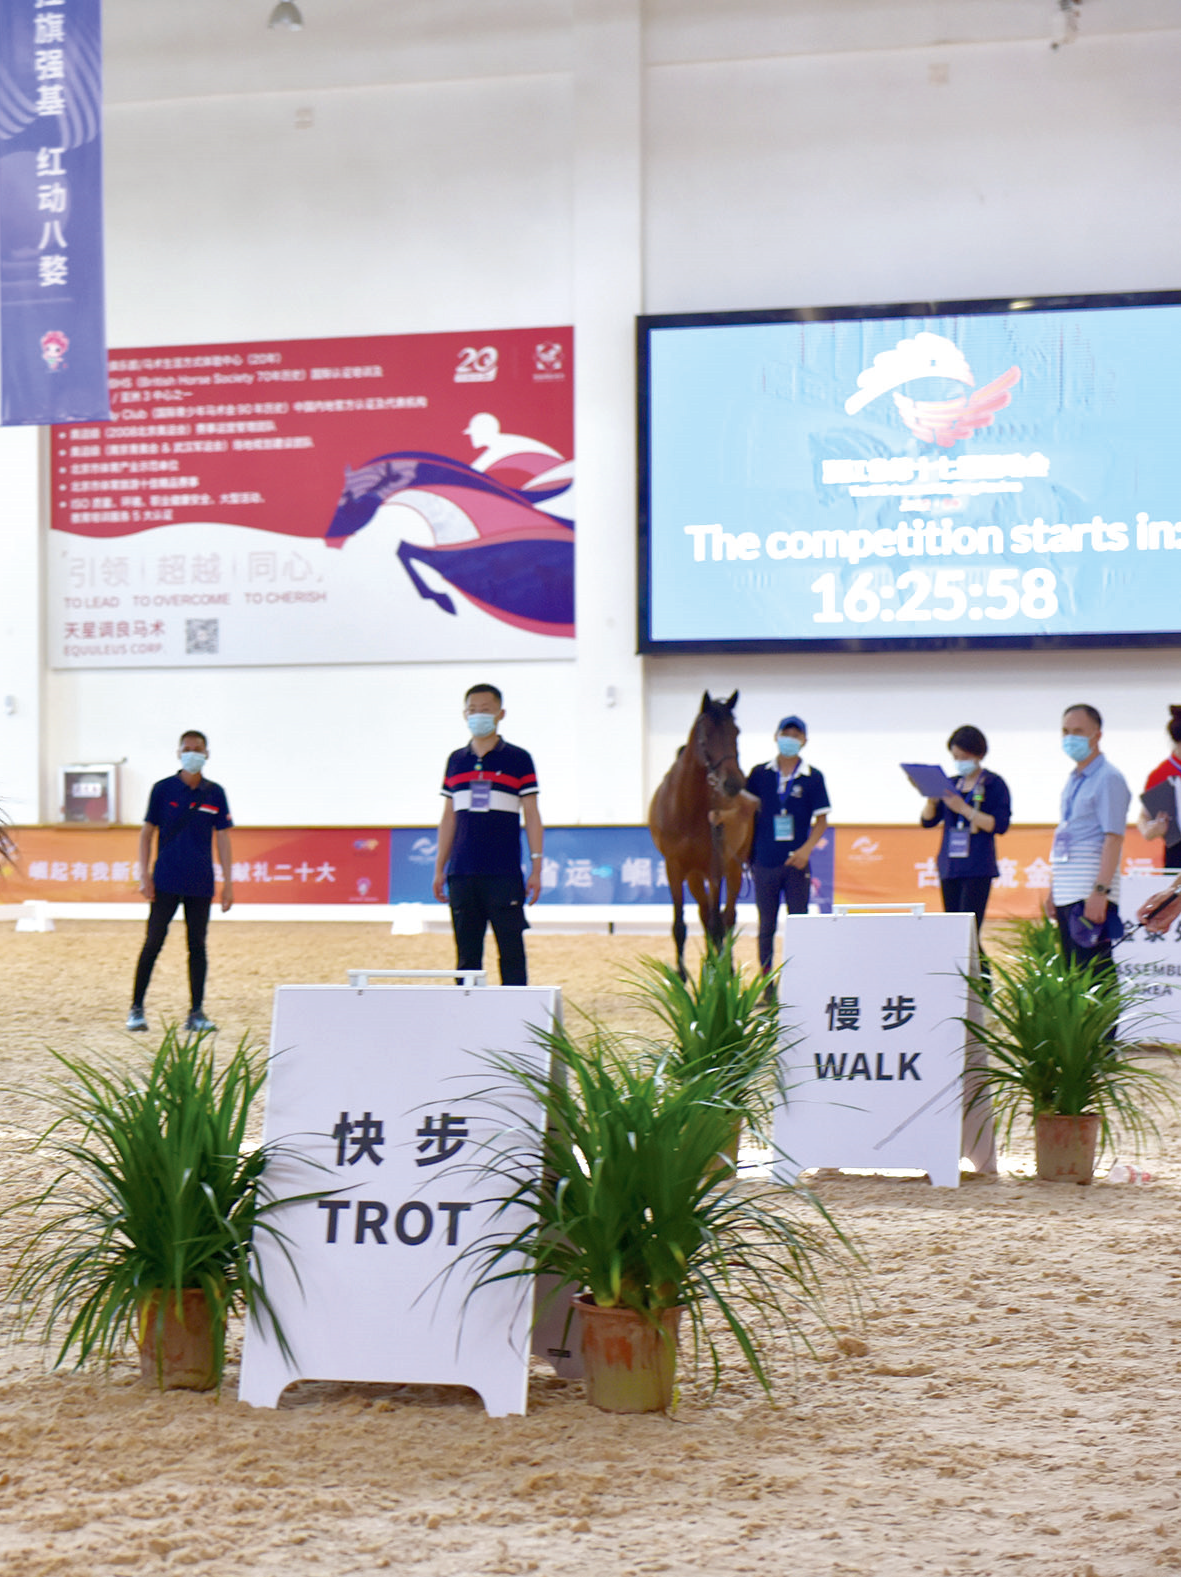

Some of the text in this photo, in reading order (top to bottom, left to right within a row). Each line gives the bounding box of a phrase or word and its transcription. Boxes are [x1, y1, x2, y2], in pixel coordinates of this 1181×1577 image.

[35, 147, 69, 287] 红动八婺
[684, 524, 761, 562] The
[766, 518, 1004, 564] competition
[1009, 516, 1129, 553] starts
[69, 550, 313, 588] 引领 超越 同心
[64, 590, 327, 609] TO LEAD TO OVERCOME TO CHERISH
[811, 568, 1058, 623] 16:25:58
[64, 643, 127, 657] EQUULEUS
[914, 856, 1052, 889] 古流金
[814, 1052, 922, 1081] WALK
[317, 1200, 472, 1246] TROT
